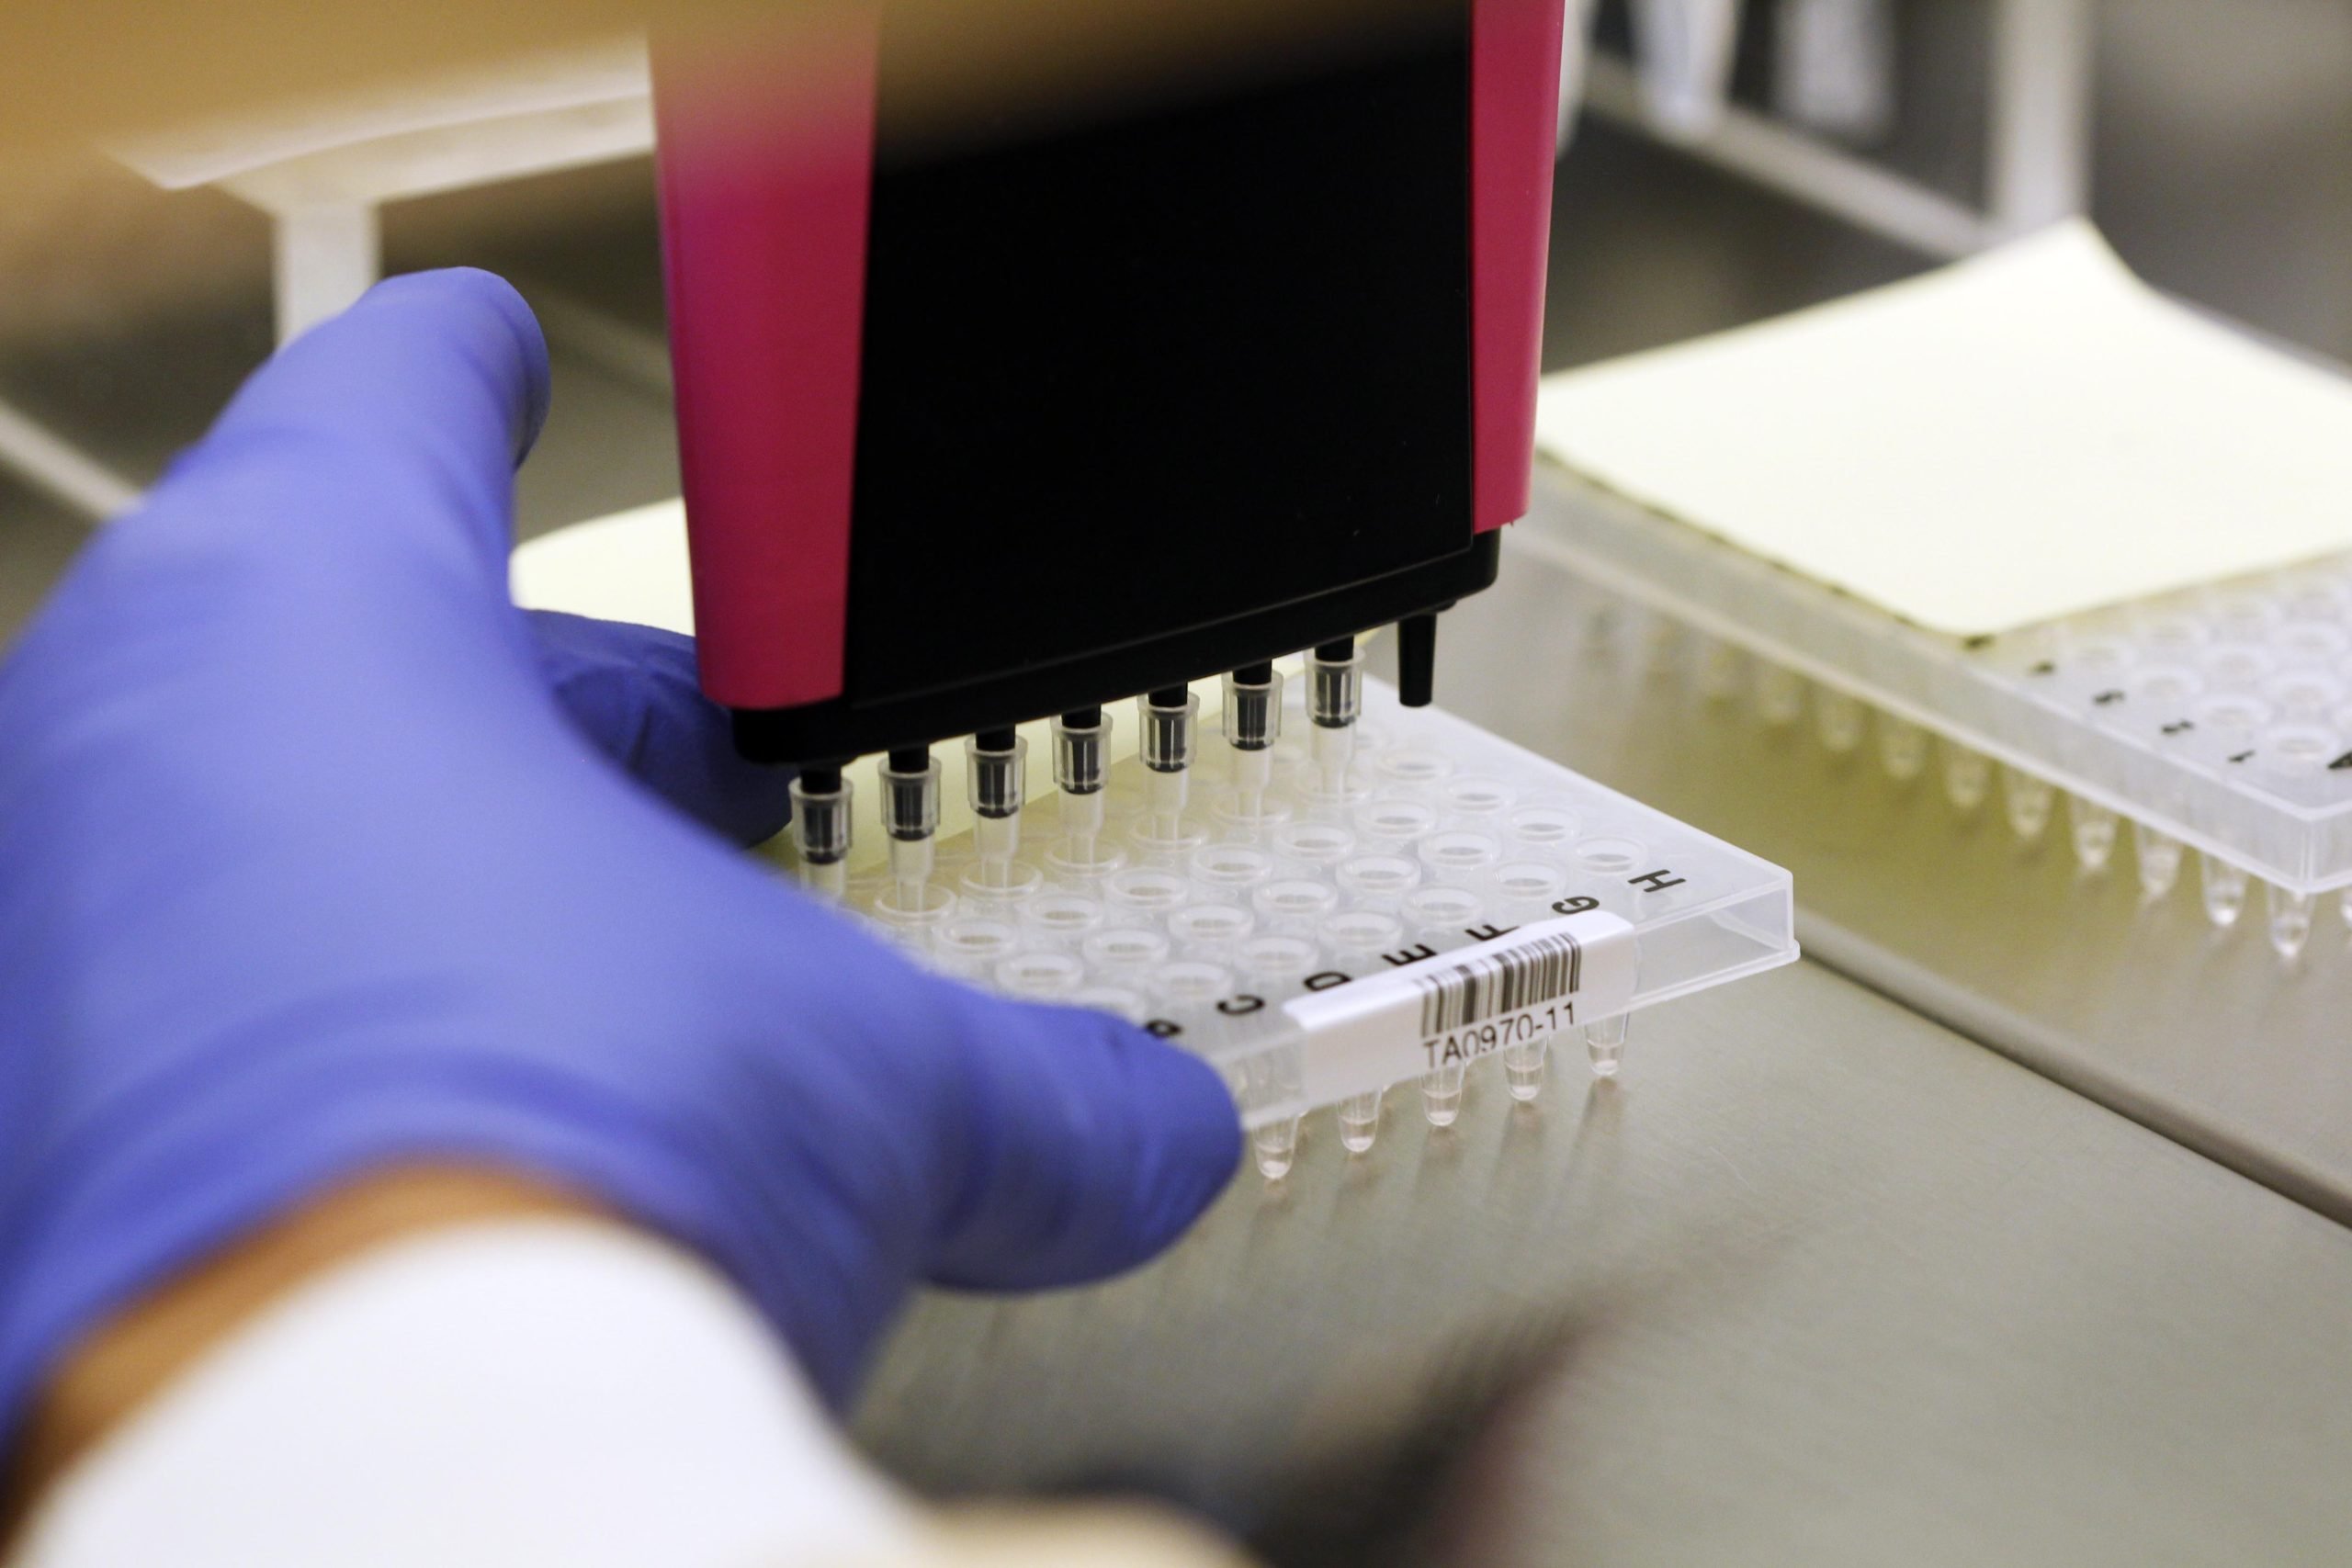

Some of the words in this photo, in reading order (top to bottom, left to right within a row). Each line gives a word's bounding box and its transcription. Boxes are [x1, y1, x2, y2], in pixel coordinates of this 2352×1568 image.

[1216, 994, 1264, 1016] C
[1304, 971, 1351, 991] D
[1382, 943, 1437, 966] E
[1464, 923, 1520, 942] F
[1552, 896, 1600, 915] G
[1627, 869, 1687, 893] H
[1424, 1001, 1575, 1068] TA0970-11
